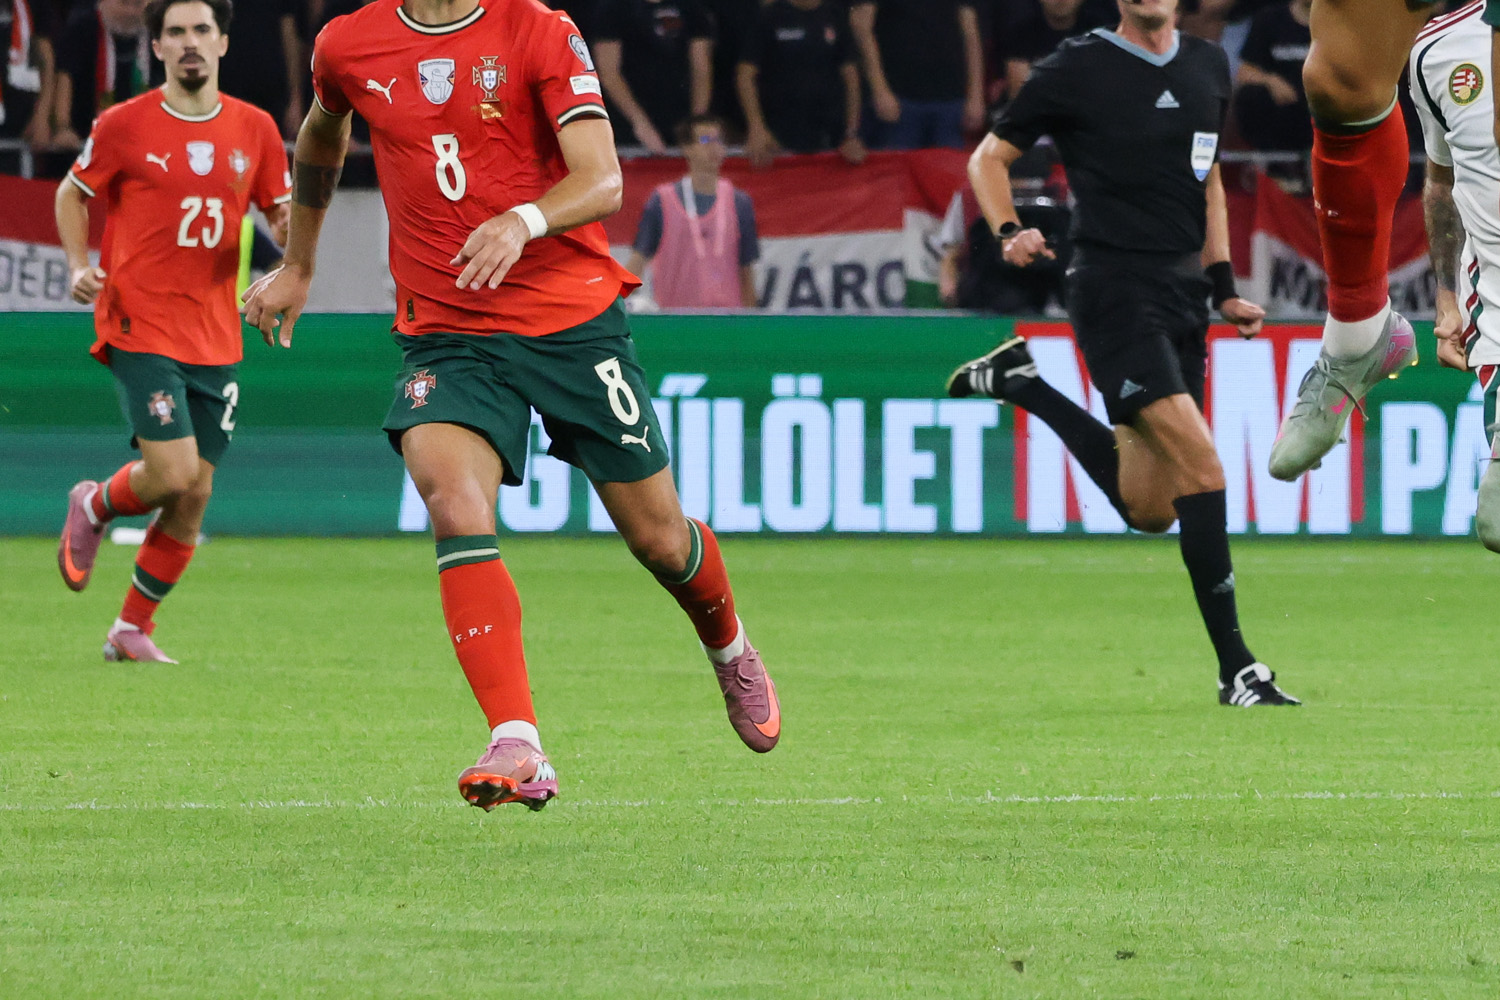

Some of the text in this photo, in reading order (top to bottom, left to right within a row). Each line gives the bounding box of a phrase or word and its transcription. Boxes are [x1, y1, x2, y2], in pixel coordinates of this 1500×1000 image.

[431, 133, 468, 202] 8
[177, 195, 225, 249] 23
[594, 356, 641, 426] 8
